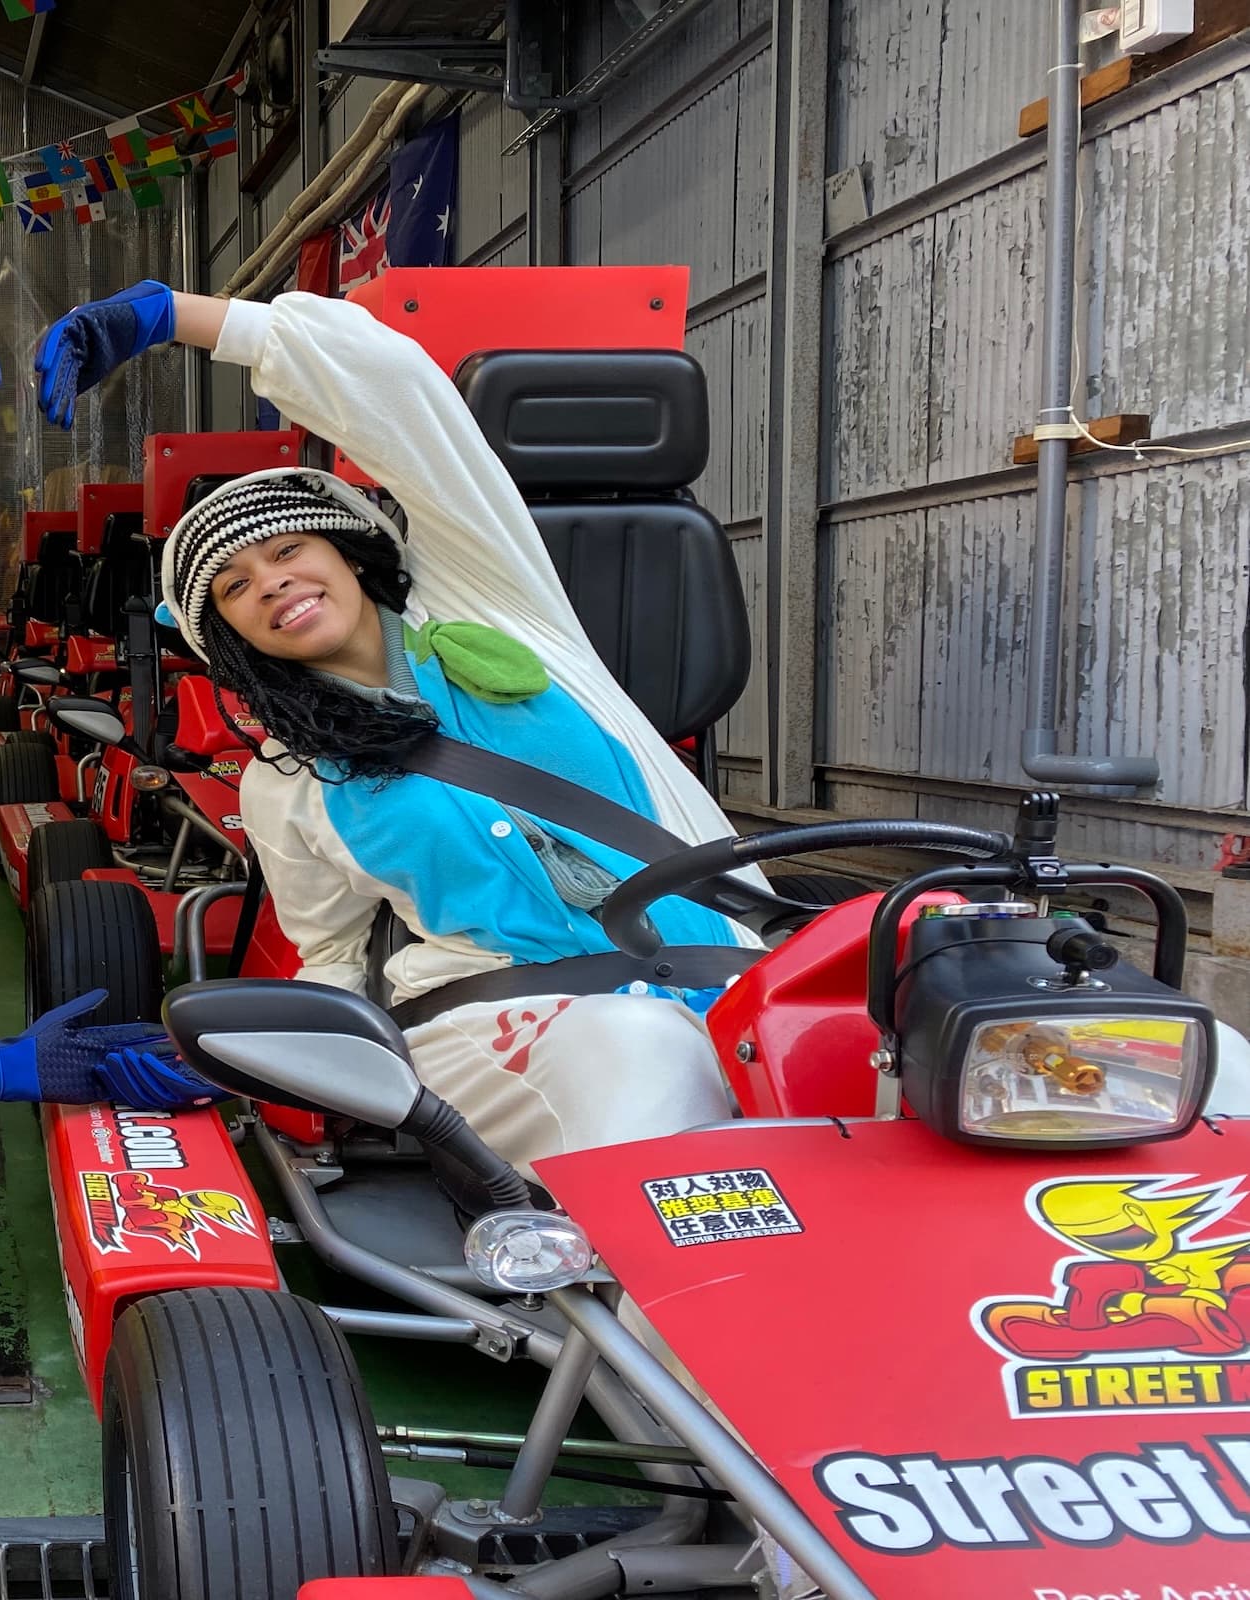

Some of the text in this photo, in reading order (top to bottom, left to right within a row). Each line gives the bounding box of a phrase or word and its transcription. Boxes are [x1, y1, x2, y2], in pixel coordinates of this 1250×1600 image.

[114, 1104, 185, 1169] t.com
[85, 1173, 111, 1202] STREET
[650, 1172, 768, 1199] 対人対物
[657, 1188, 781, 1220] 推奨基準
[669, 1208, 792, 1238] 任意保険
[1027, 1365, 1222, 1408] STREET
[823, 1449, 1250, 1549] Street
